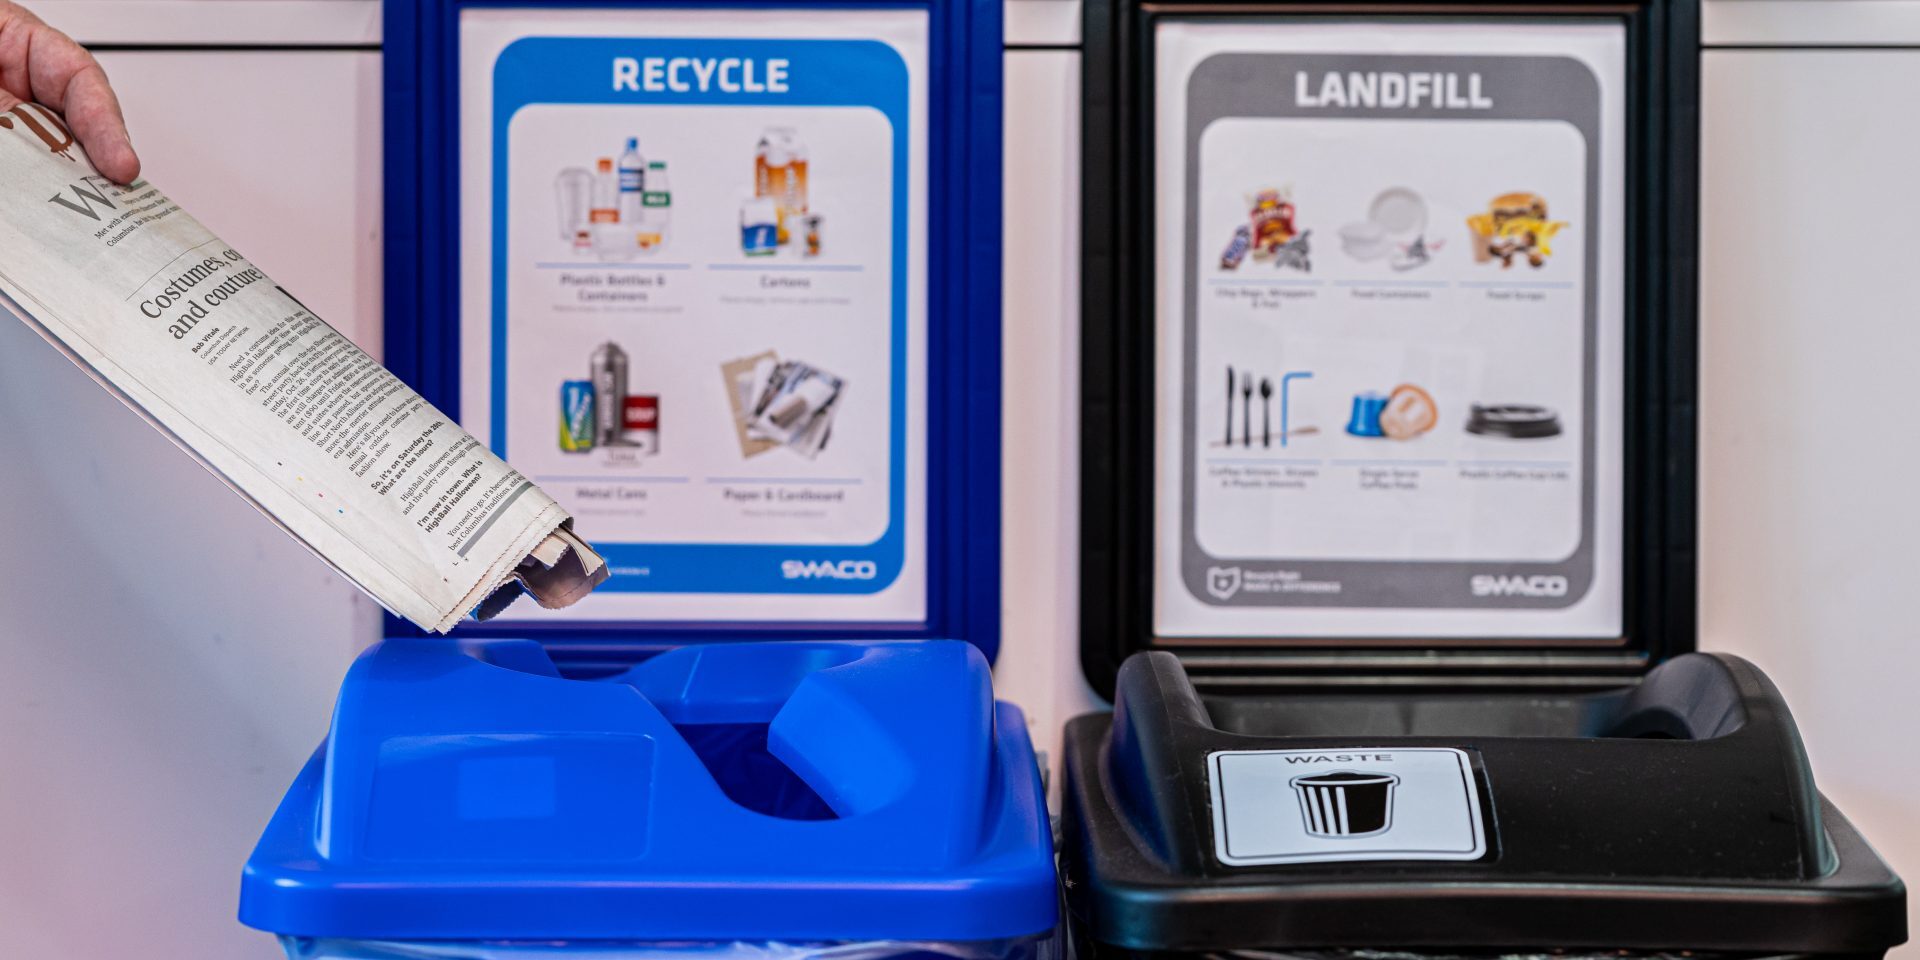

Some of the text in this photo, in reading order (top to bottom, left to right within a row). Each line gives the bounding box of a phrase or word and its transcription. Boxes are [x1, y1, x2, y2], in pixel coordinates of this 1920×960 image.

[613, 57, 790, 93] RECYCLE
[1295, 71, 1494, 109] LANDFILL
[139, 256, 233, 319] Costumes,
[167, 267, 263, 340] and couture
[191, 327, 220, 354] Bob Vitale
[200, 325, 237, 360] Columbus Dispatch
[207, 326, 250, 366] USA TODAY NETWORK
[228, 354, 246, 371] Need
[248, 333, 270, 352] costume
[267, 326, 280, 336] idea
[229, 358, 255, 384] HighBall
[251, 336, 280, 361] Halloween?
[252, 353, 275, 375] someone
[273, 340, 293, 356] getting
[245, 379, 261, 396] free?
[259, 382, 273, 394] The
[271, 364, 290, 384] annual
[262, 389, 279, 407] street
[276, 373, 295, 393] party,
[289, 365, 305, 378] back
[269, 395, 289, 413] urday,
[295, 376, 308, 386] 26,
[277, 408, 289, 418] the
[285, 396, 300, 410] first
[297, 385, 311, 398] time
[309, 373, 324, 387] since
[286, 414, 297, 425] are
[294, 401, 307, 416] still
[305, 384, 326, 404] charges
[322, 378, 333, 386] for
[292, 417, 306, 430] tent
[303, 404, 319, 419] ($90
[316, 392, 331, 406] until
[327, 380, 347, 395] Friday,
[301, 423, 314, 437] and
[311, 407, 329, 426] suites
[326, 393, 344, 409] where
[341, 387, 352, 395] the
[307, 430, 321, 443] line
[319, 418, 333, 430] has
[331, 399, 353, 420] passed,
[349, 391, 362, 400] but
[316, 431, 333, 448] Short
[330, 416, 348, 433] North
[345, 399, 366, 419] Alliance
[333, 421, 371, 459] eral admission.
[345, 440, 365, 459] Here's
[363, 432, 372, 442] all
[369, 423, 381, 437] you
[378, 413, 392, 427] need
[348, 451, 368, 472] annual
[368, 429, 390, 450] outdoor
[390, 411, 411, 429] costume
[370, 481, 384, 490] So,
[379, 469, 392, 480] it's
[397, 436, 425, 461] Saturday
[421, 428, 433, 438] the
[355, 442, 392, 478] fashion show.
[377, 439, 434, 496] What are the hours?
[400, 475, 426, 502] HighBall
[422, 451, 451, 477] Halloween
[448, 440, 463, 453] starts
[402, 449, 467, 515] and the party runs through
[416, 515, 430, 527] I'm
[427, 501, 442, 516] new
[445, 479, 465, 495] town.
[461, 464, 478, 479] What
[424, 473, 482, 533] HighBall Halloween?
[447, 525, 461, 537] You
[458, 510, 473, 527] need
[476, 498, 487, 508] go.
[482, 487, 494, 499] It's
[447, 537, 463, 551] best
[459, 509, 488, 538] Columbus
[484, 487, 513, 512] traditions,
[781, 560, 877, 579] SWACO
[1285, 754, 1393, 764] WASTE
